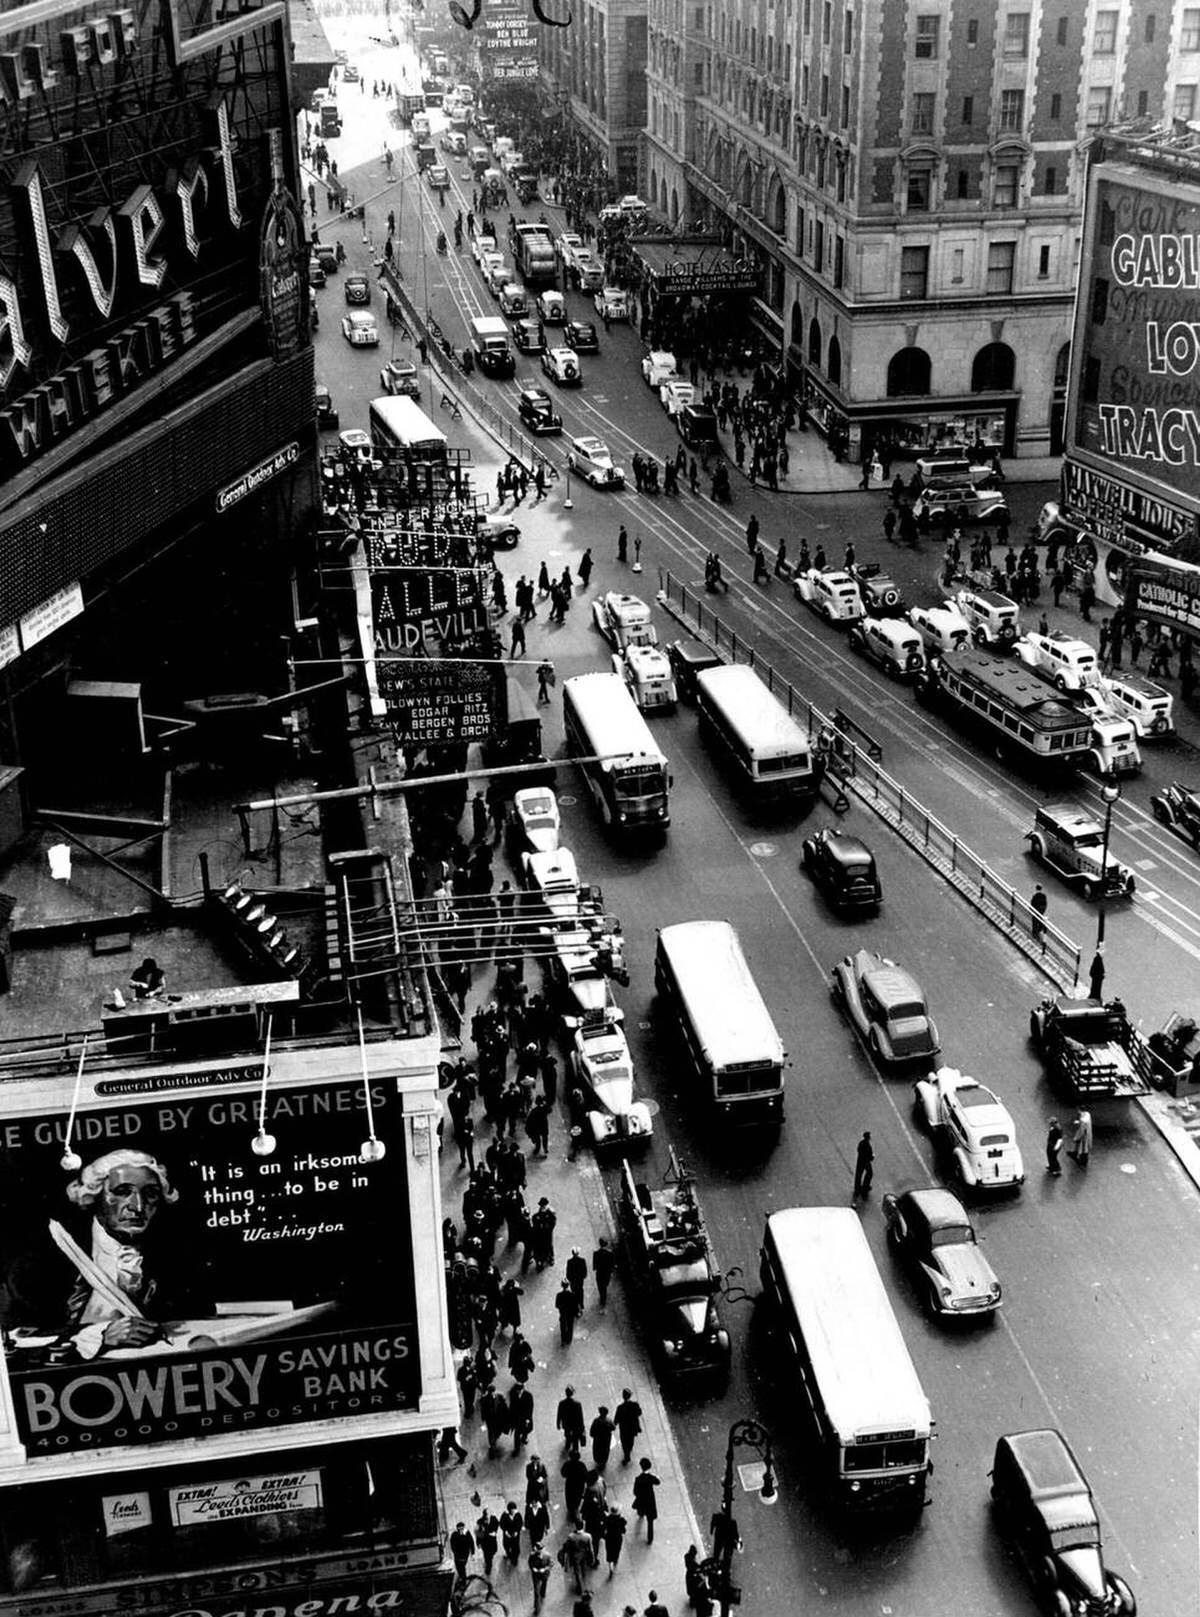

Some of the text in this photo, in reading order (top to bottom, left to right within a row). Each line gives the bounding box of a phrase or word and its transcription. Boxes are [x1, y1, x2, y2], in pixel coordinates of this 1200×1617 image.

[1111, 234, 1200, 288] GABL
[370, 515, 477, 573] RUDY
[1139, 582, 1189, 609] CATHOLIC
[374, 604, 502, 652] AUDEVILLE
[385, 697, 431, 709] OLDWYN
[411, 703, 488, 718] EDGAR RITZ
[395, 725, 489, 741] VALLEE & ORCH
[411, 717, 455, 729] BERGEN
[462, 714, 491, 725] BROS
[103, 1078, 153, 1095] General
[156, 1073, 212, 1089] Outdoor
[215, 1071, 241, 1083] Adv
[0, 1086, 387, 1148] E GUIDED BY GREATNESS
[228, 1162, 244, 1179] is
[259, 1163, 281, 1175] an
[314, 1176, 339, 1192] be
[352, 1172, 368, 1188] in
[242, 1222, 345, 1242] Washington
[24, 1336, 409, 1433] BOWERY SAVINGS
[304, 1367, 388, 1398] BANK
[37, 1391, 406, 1447] 400,000 DEPOSITORS
[177, 1475, 306, 1501] EXTRA! EXTRA!
[192, 1488, 299, 1514] Leeds Clothiers
[219, 1502, 287, 1518] EXPANDING
